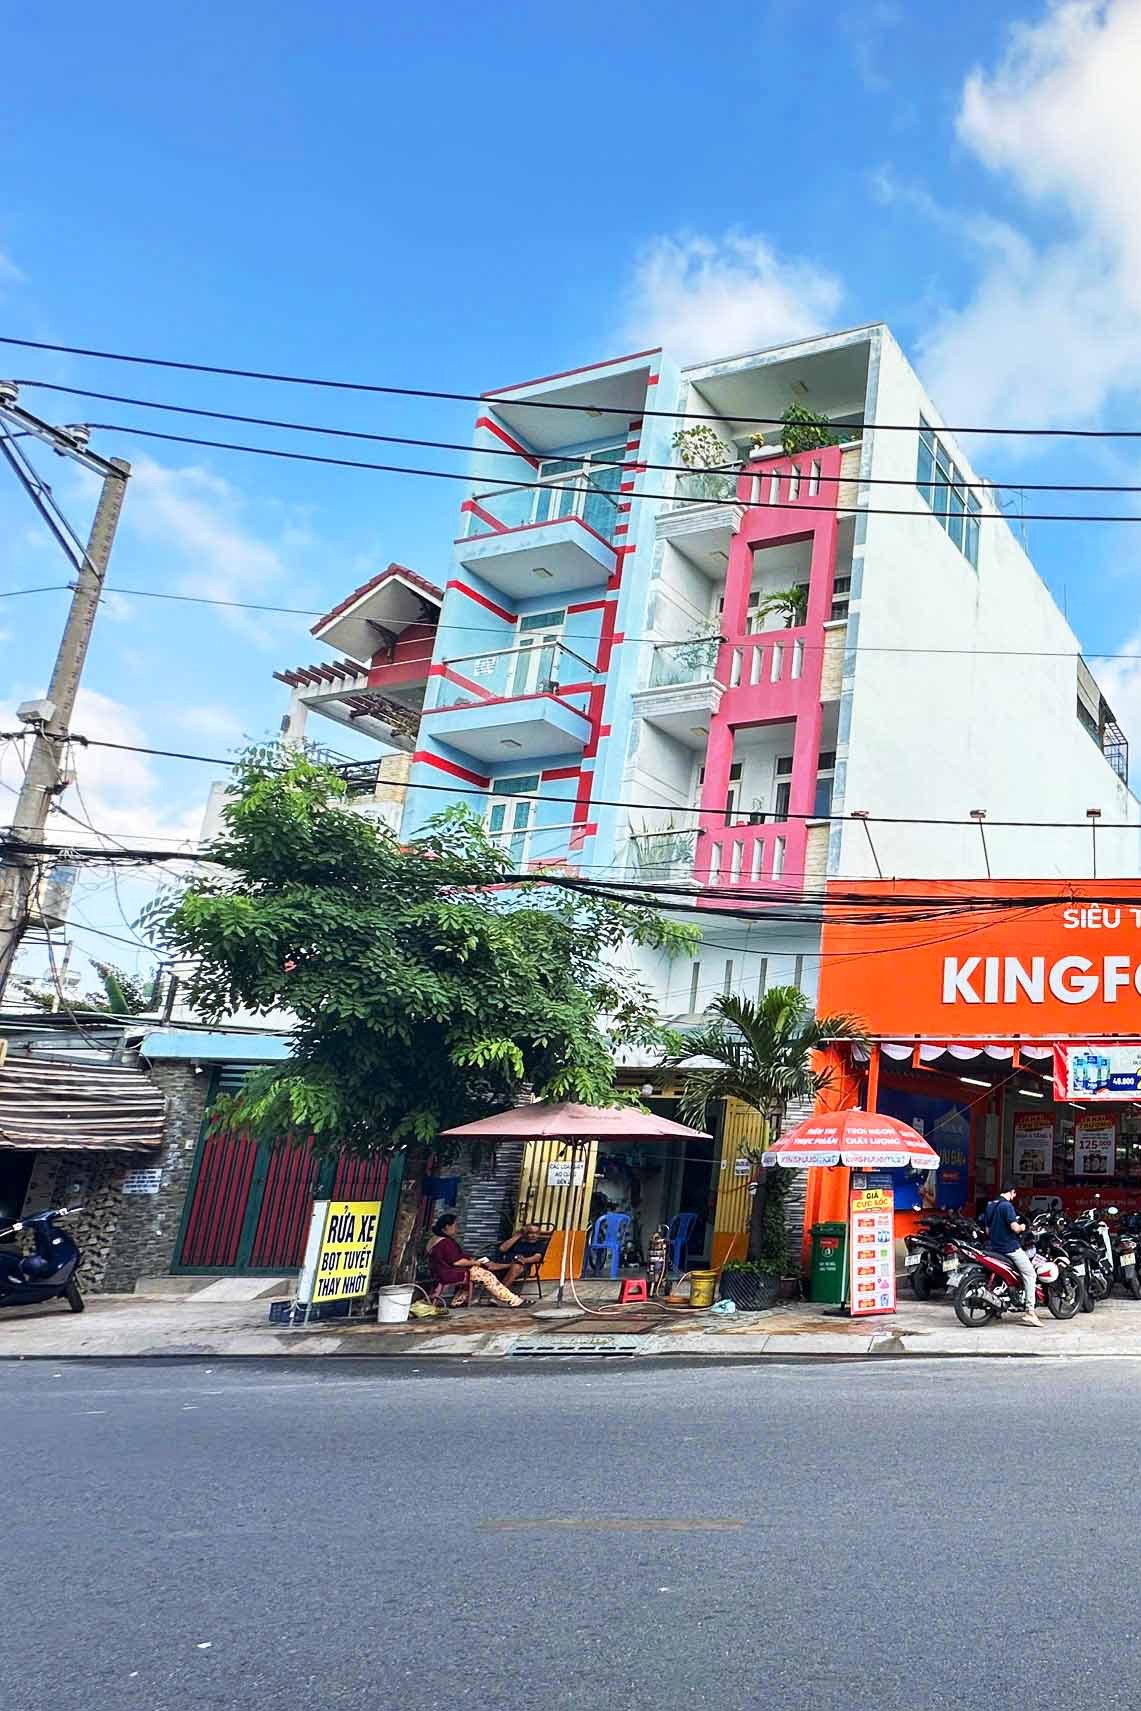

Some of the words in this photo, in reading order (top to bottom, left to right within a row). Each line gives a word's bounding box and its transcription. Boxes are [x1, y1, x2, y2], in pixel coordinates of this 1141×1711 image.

[1064, 903, 1120, 928] SIÊU
[327, 1205, 355, 1243] RỬA
[358, 1215, 376, 1242] XE
[343, 1244, 371, 1270] TUYẾT
